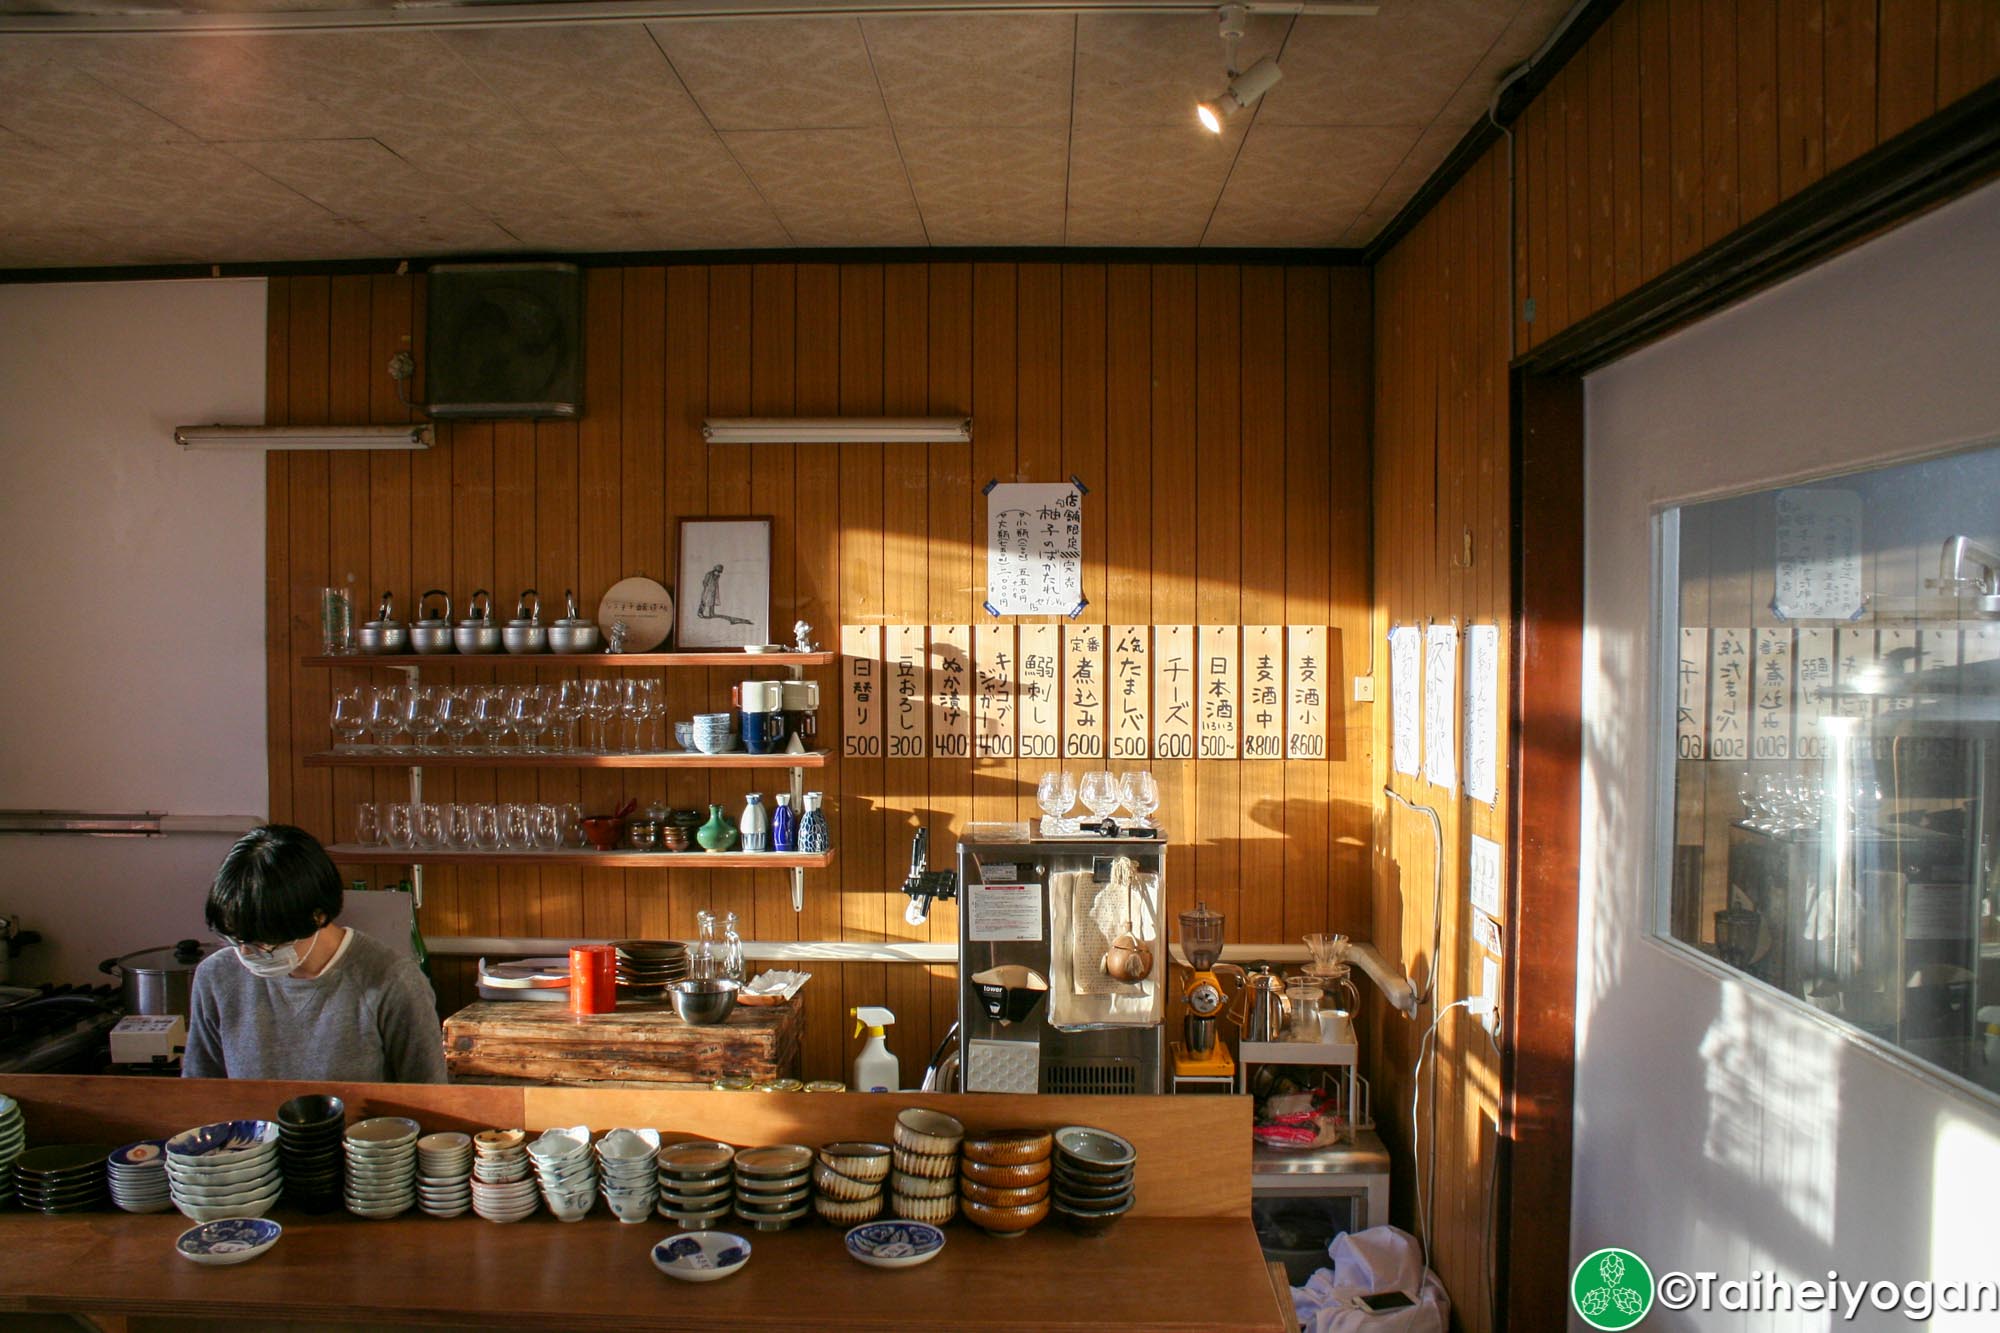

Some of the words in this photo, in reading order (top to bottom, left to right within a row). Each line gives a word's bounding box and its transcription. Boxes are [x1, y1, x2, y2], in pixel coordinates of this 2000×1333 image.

[1071, 636, 1100, 652] 定番
[1116, 638, 1144, 653] 人気
[853, 658, 873, 725] 日替り
[897, 656, 916, 730] 豆おろし
[939, 657, 963, 726] ぬか漬け
[1025, 654, 1053, 724] 鰯刺し
[1072, 657, 1099, 727] 煮込み
[1163, 657, 1189, 726] チーズ
[1206, 657, 1233, 719] 日本酒
[1252, 654, 1276, 729] 麦酒中
[1295, 655, 1320, 725] 麦酒小
[846, 735, 879, 756] 500
[889, 735, 922, 756] 300
[935, 733, 967, 756] 400
[980, 734, 1012, 755] 400
[1022, 735, 1056, 756] 500
[1068, 734, 1100, 756] 600
[1114, 736, 1146, 756] 500
[1158, 734, 1192, 757] 600
[983, 985, 1003, 993] tower
